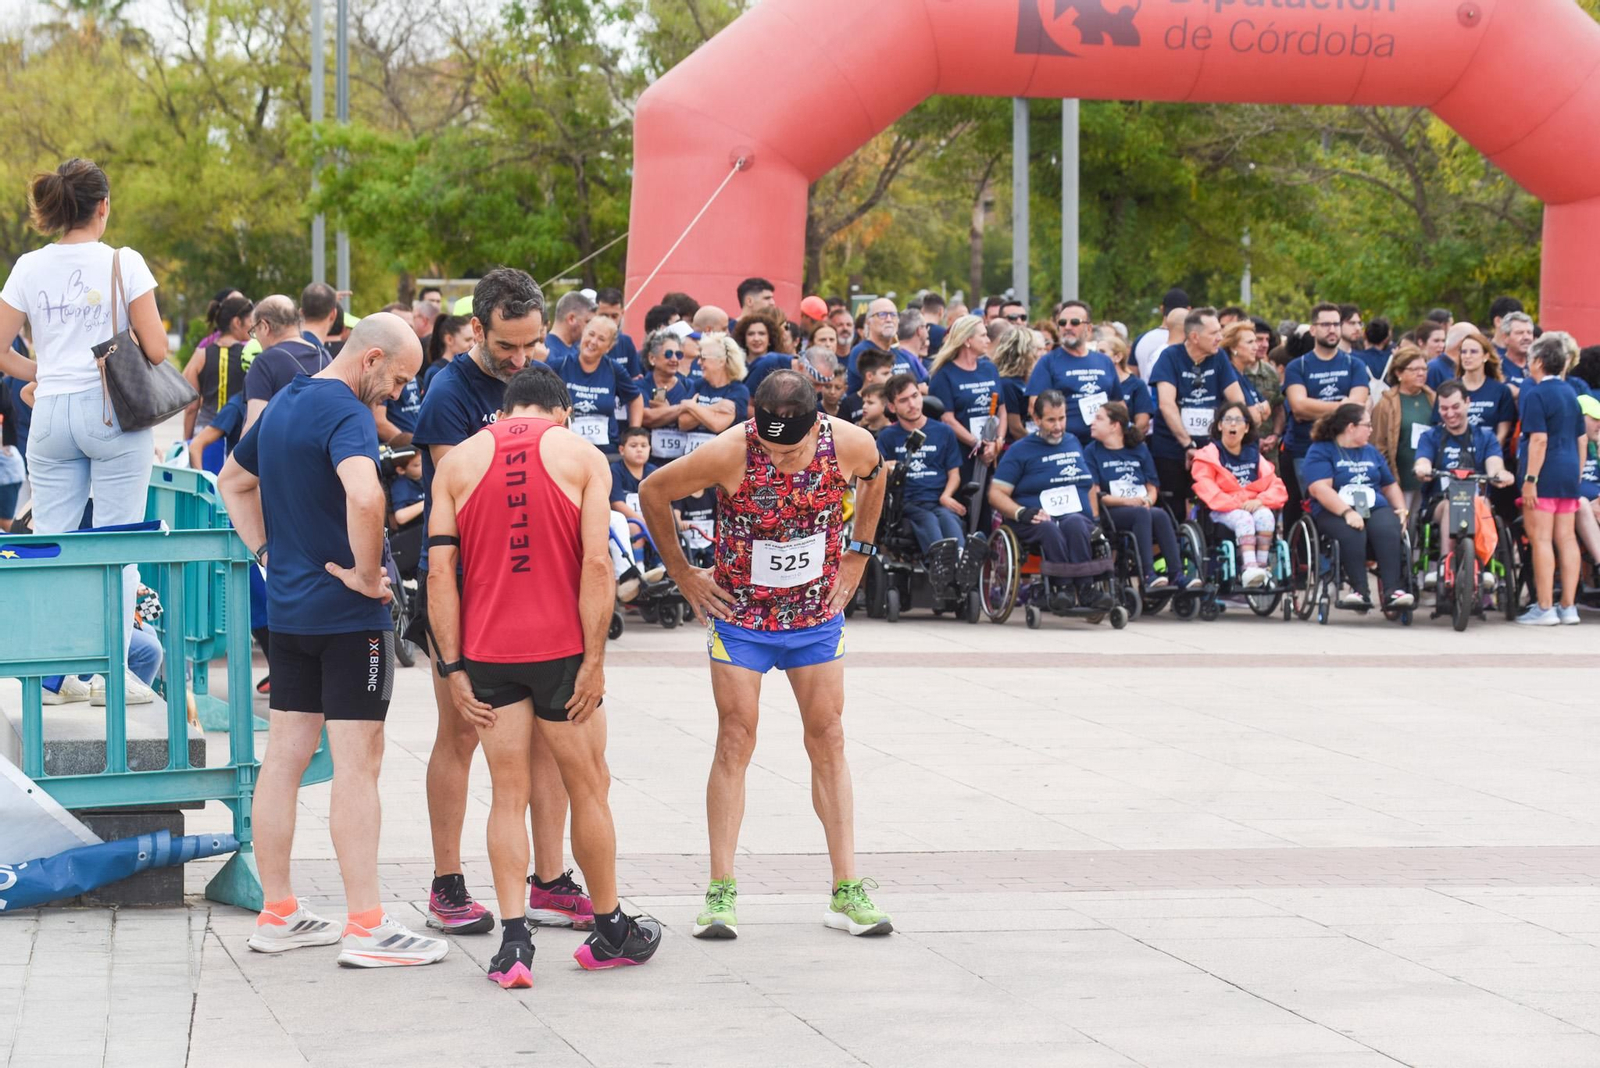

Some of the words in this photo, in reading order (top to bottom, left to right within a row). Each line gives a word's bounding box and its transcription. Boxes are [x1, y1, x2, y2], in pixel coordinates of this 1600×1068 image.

[1164, 16, 1213, 51] de
[1229, 18, 1396, 58] Córdoba
[66, 269, 92, 301] Be
[1190, 417, 1208, 427] 198
[581, 425, 601, 436] 155
[660, 438, 681, 450] 159
[1120, 487, 1138, 498] 285
[1050, 494, 1069, 507] 527
[505, 450, 532, 574] NELEUS
[769, 551, 810, 572] 525
